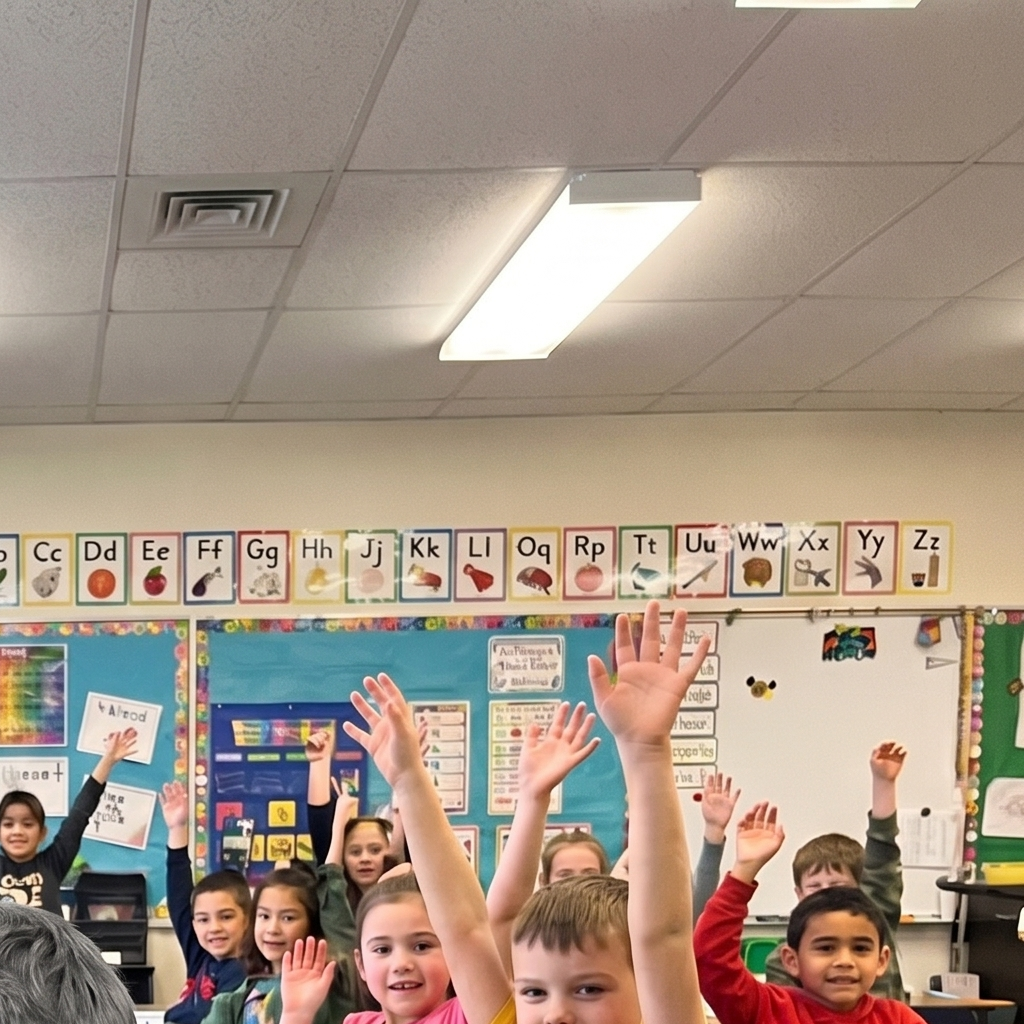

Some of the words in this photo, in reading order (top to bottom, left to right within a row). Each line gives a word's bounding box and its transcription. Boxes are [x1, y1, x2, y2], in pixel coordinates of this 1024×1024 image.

[33, 541, 62, 563] Cc
[84, 539, 117, 562] Dd
[142, 539, 170, 561] Ee
[197, 537, 224, 560] Ff
[246, 538, 279, 569] Gg
[302, 538, 333, 559] Hh
[360, 538, 383, 569] Jj
[410, 535, 440, 558] Kk
[468, 536, 491, 558] Ll
[574, 535, 605, 563] Rp
[633, 534, 657, 555] Tt
[685, 532, 716, 554] Uu
[738, 529, 779, 552] Ww
[797, 529, 829, 552] Xx
[857, 528, 885, 559] Yy
[913, 529, 940, 551] Zz
